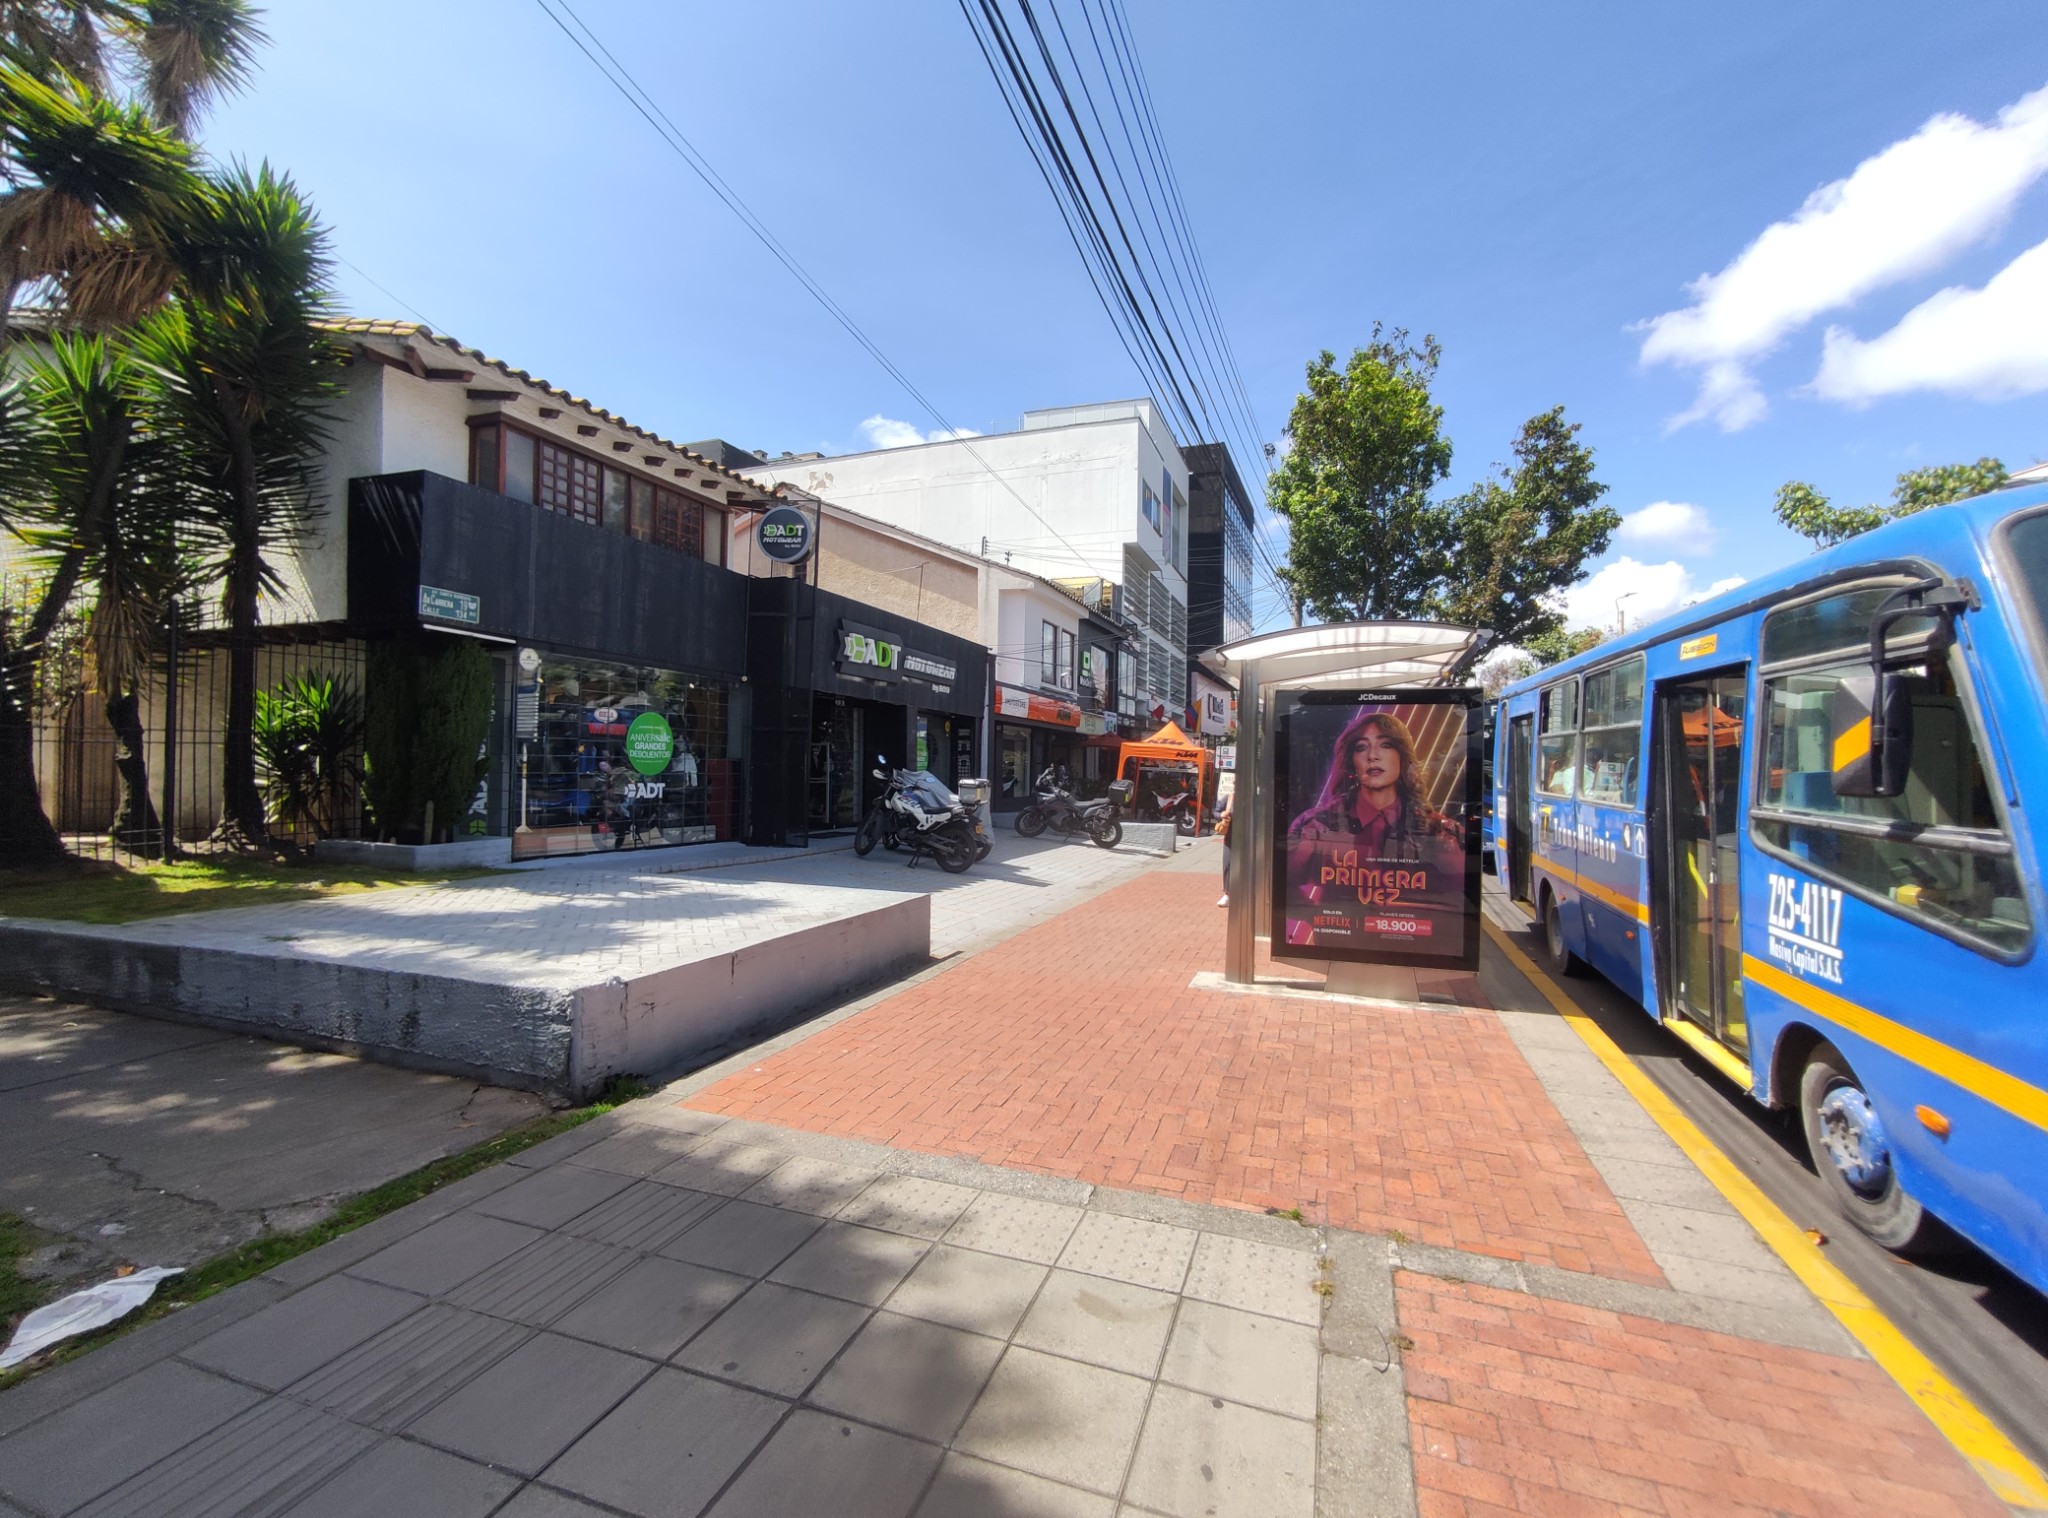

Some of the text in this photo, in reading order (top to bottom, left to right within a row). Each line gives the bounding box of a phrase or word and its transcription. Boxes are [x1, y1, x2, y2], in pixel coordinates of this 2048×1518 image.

[863, 638, 901, 670] ADT
[629, 750, 671, 758] DESCUENTOS
[634, 742, 667, 750] GRANDES
[636, 783, 666, 799] ADT
[1332, 849, 1358, 867] LA
[1320, 866, 1427, 890] PRIMERA
[1357, 886, 1401, 906] VEZ
[1768, 873, 1843, 946] Z25-4117
[1313, 915, 1351, 928] NETFLIX
[1375, 919, 1417, 932] 18.900
[1769, 934, 1792, 963] Masivo
[1792, 944, 1819, 975] Capital
